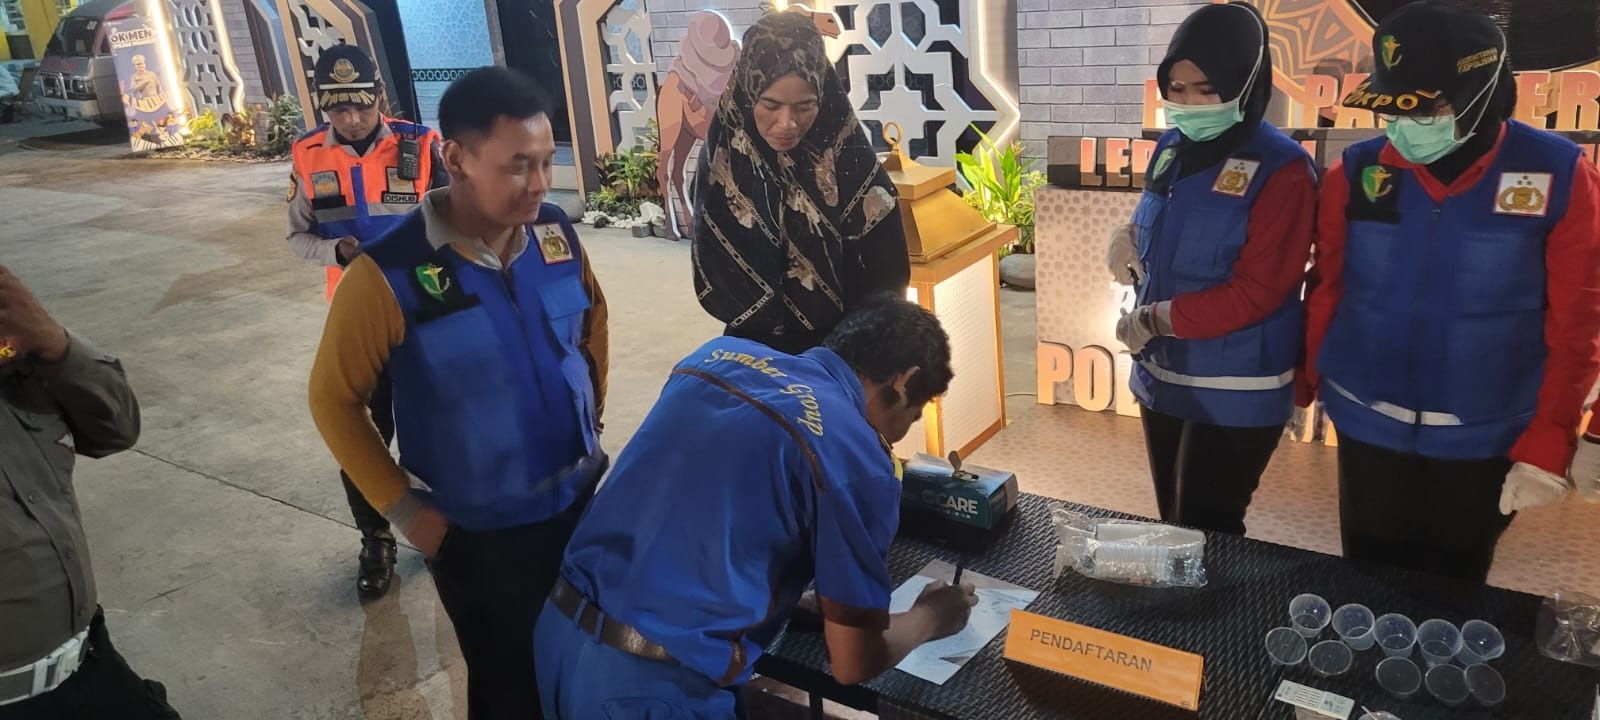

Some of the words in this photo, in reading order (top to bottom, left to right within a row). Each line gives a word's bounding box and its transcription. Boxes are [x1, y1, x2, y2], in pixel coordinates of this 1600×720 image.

[704, 349, 788, 378] Sumber
[779, 383, 824, 436] Group
[1030, 628, 1152, 673] PENDAFTARAN
